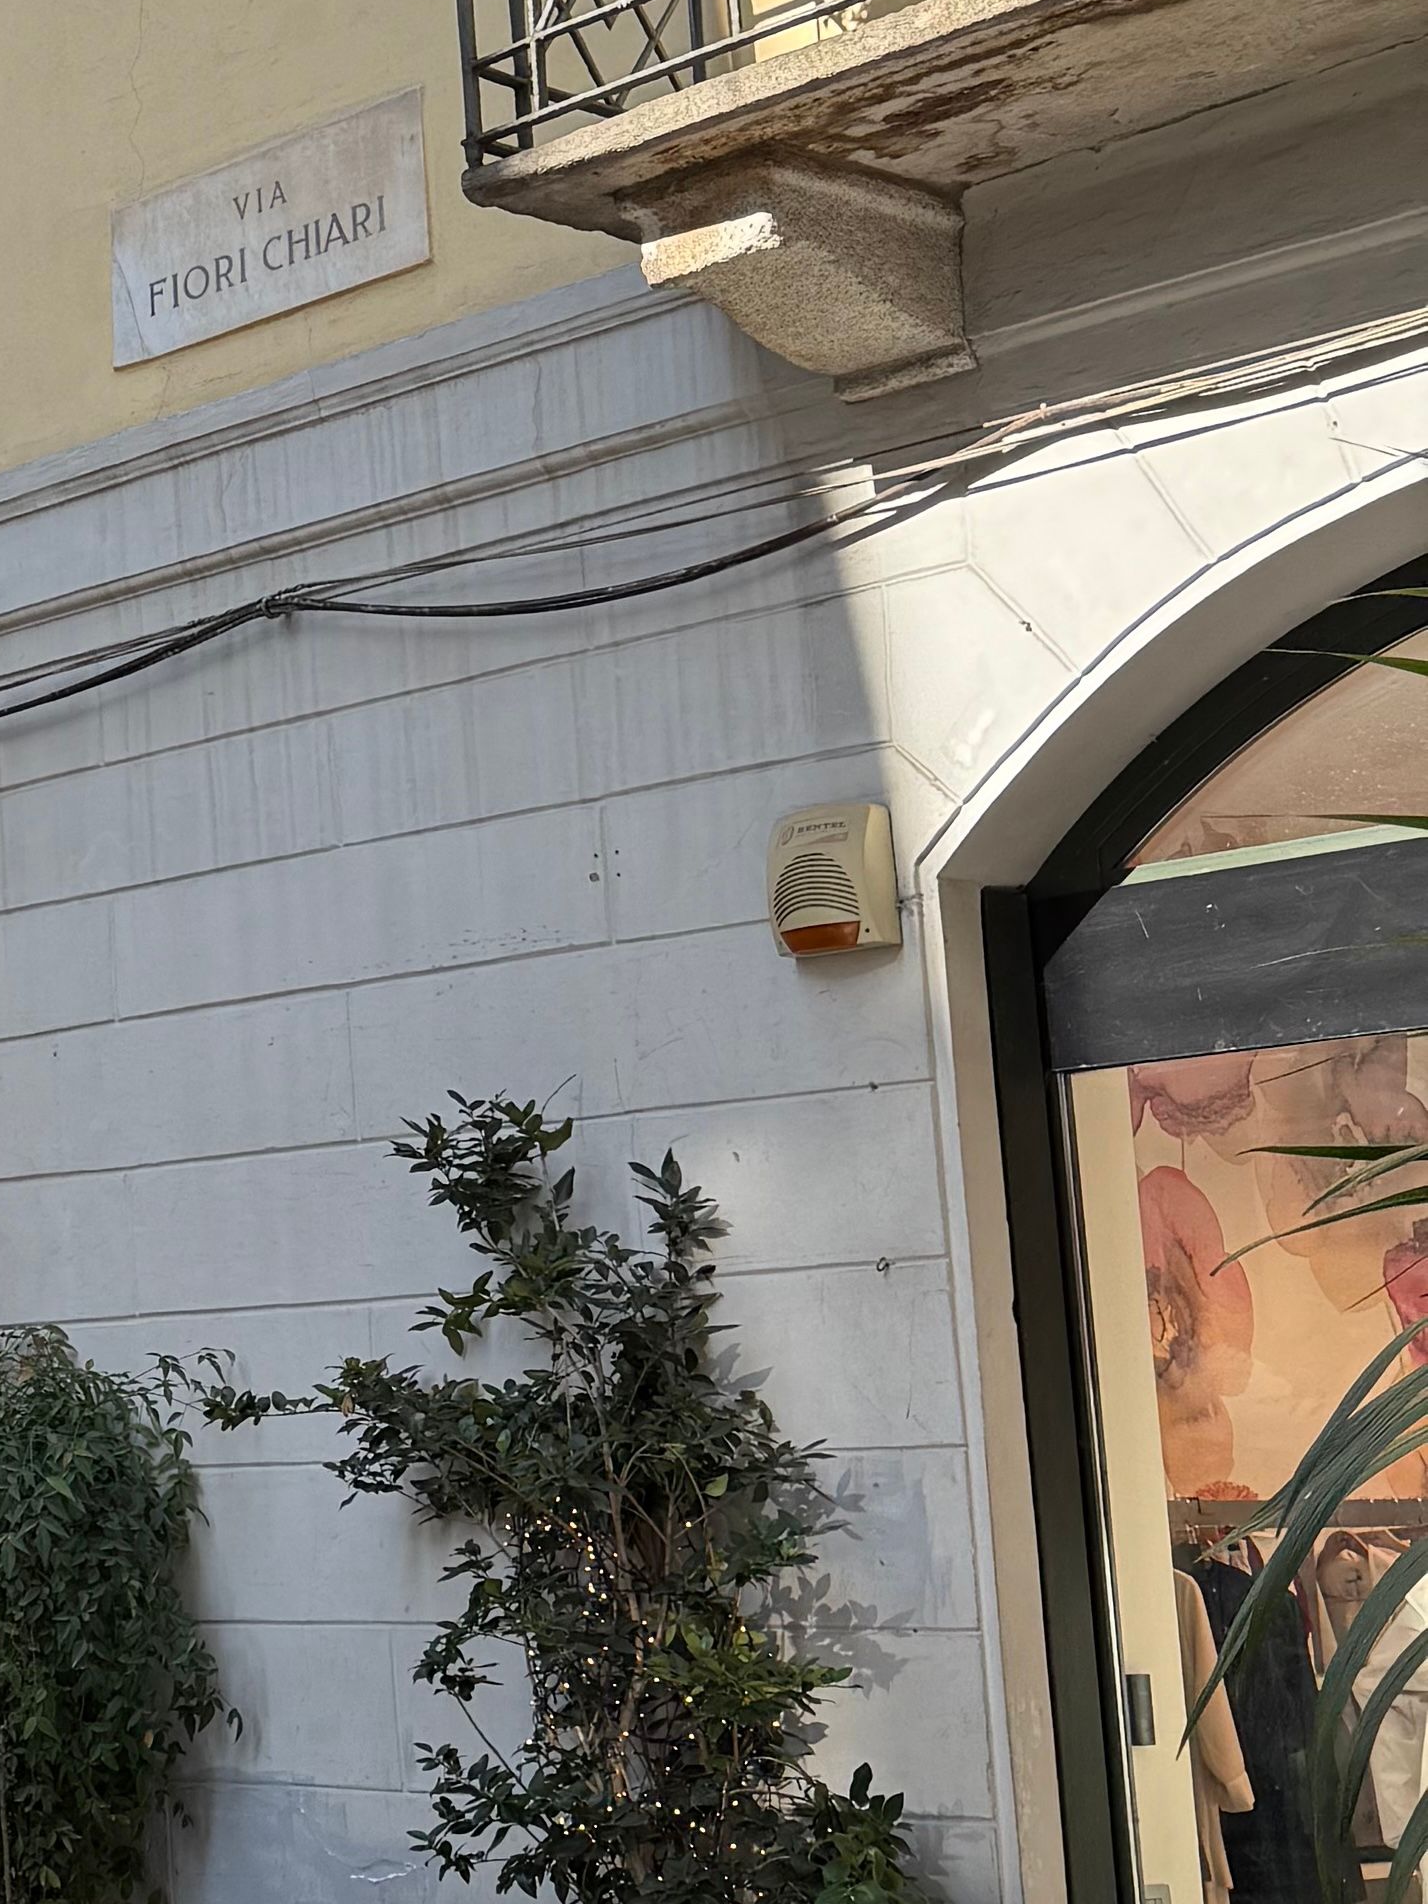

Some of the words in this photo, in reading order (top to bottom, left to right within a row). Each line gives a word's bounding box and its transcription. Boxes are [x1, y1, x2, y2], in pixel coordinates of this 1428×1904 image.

[233, 181, 287, 220] VIA
[149, 247, 247, 317] FIORI
[263, 195, 386, 271] CHIARI
